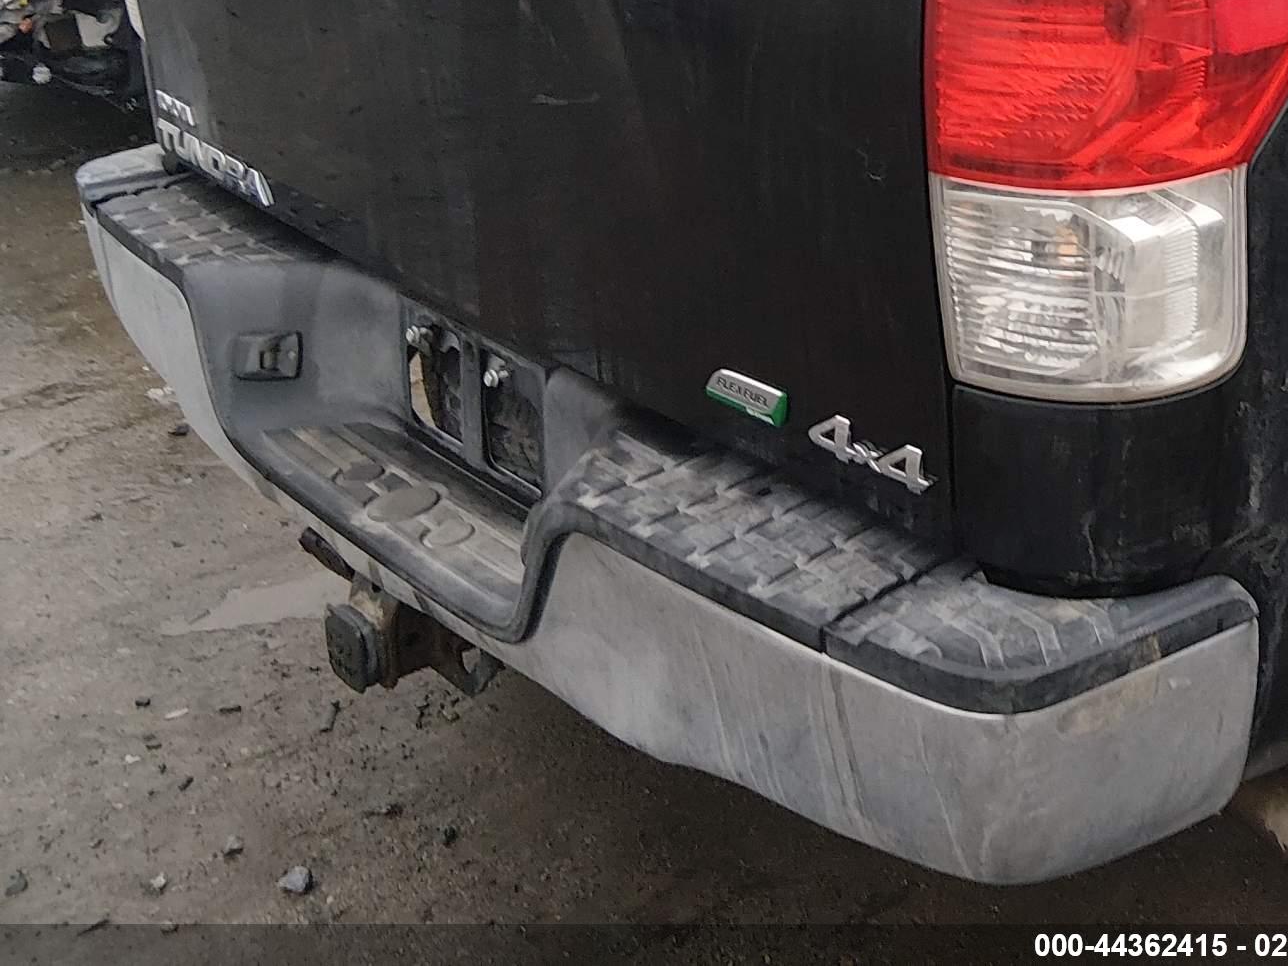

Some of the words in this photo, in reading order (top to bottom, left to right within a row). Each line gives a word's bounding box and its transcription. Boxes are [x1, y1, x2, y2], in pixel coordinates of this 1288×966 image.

[157, 116, 275, 207] TUNDRA
[715, 376, 744, 396] FLEX
[744, 387, 769, 408] FUEL
